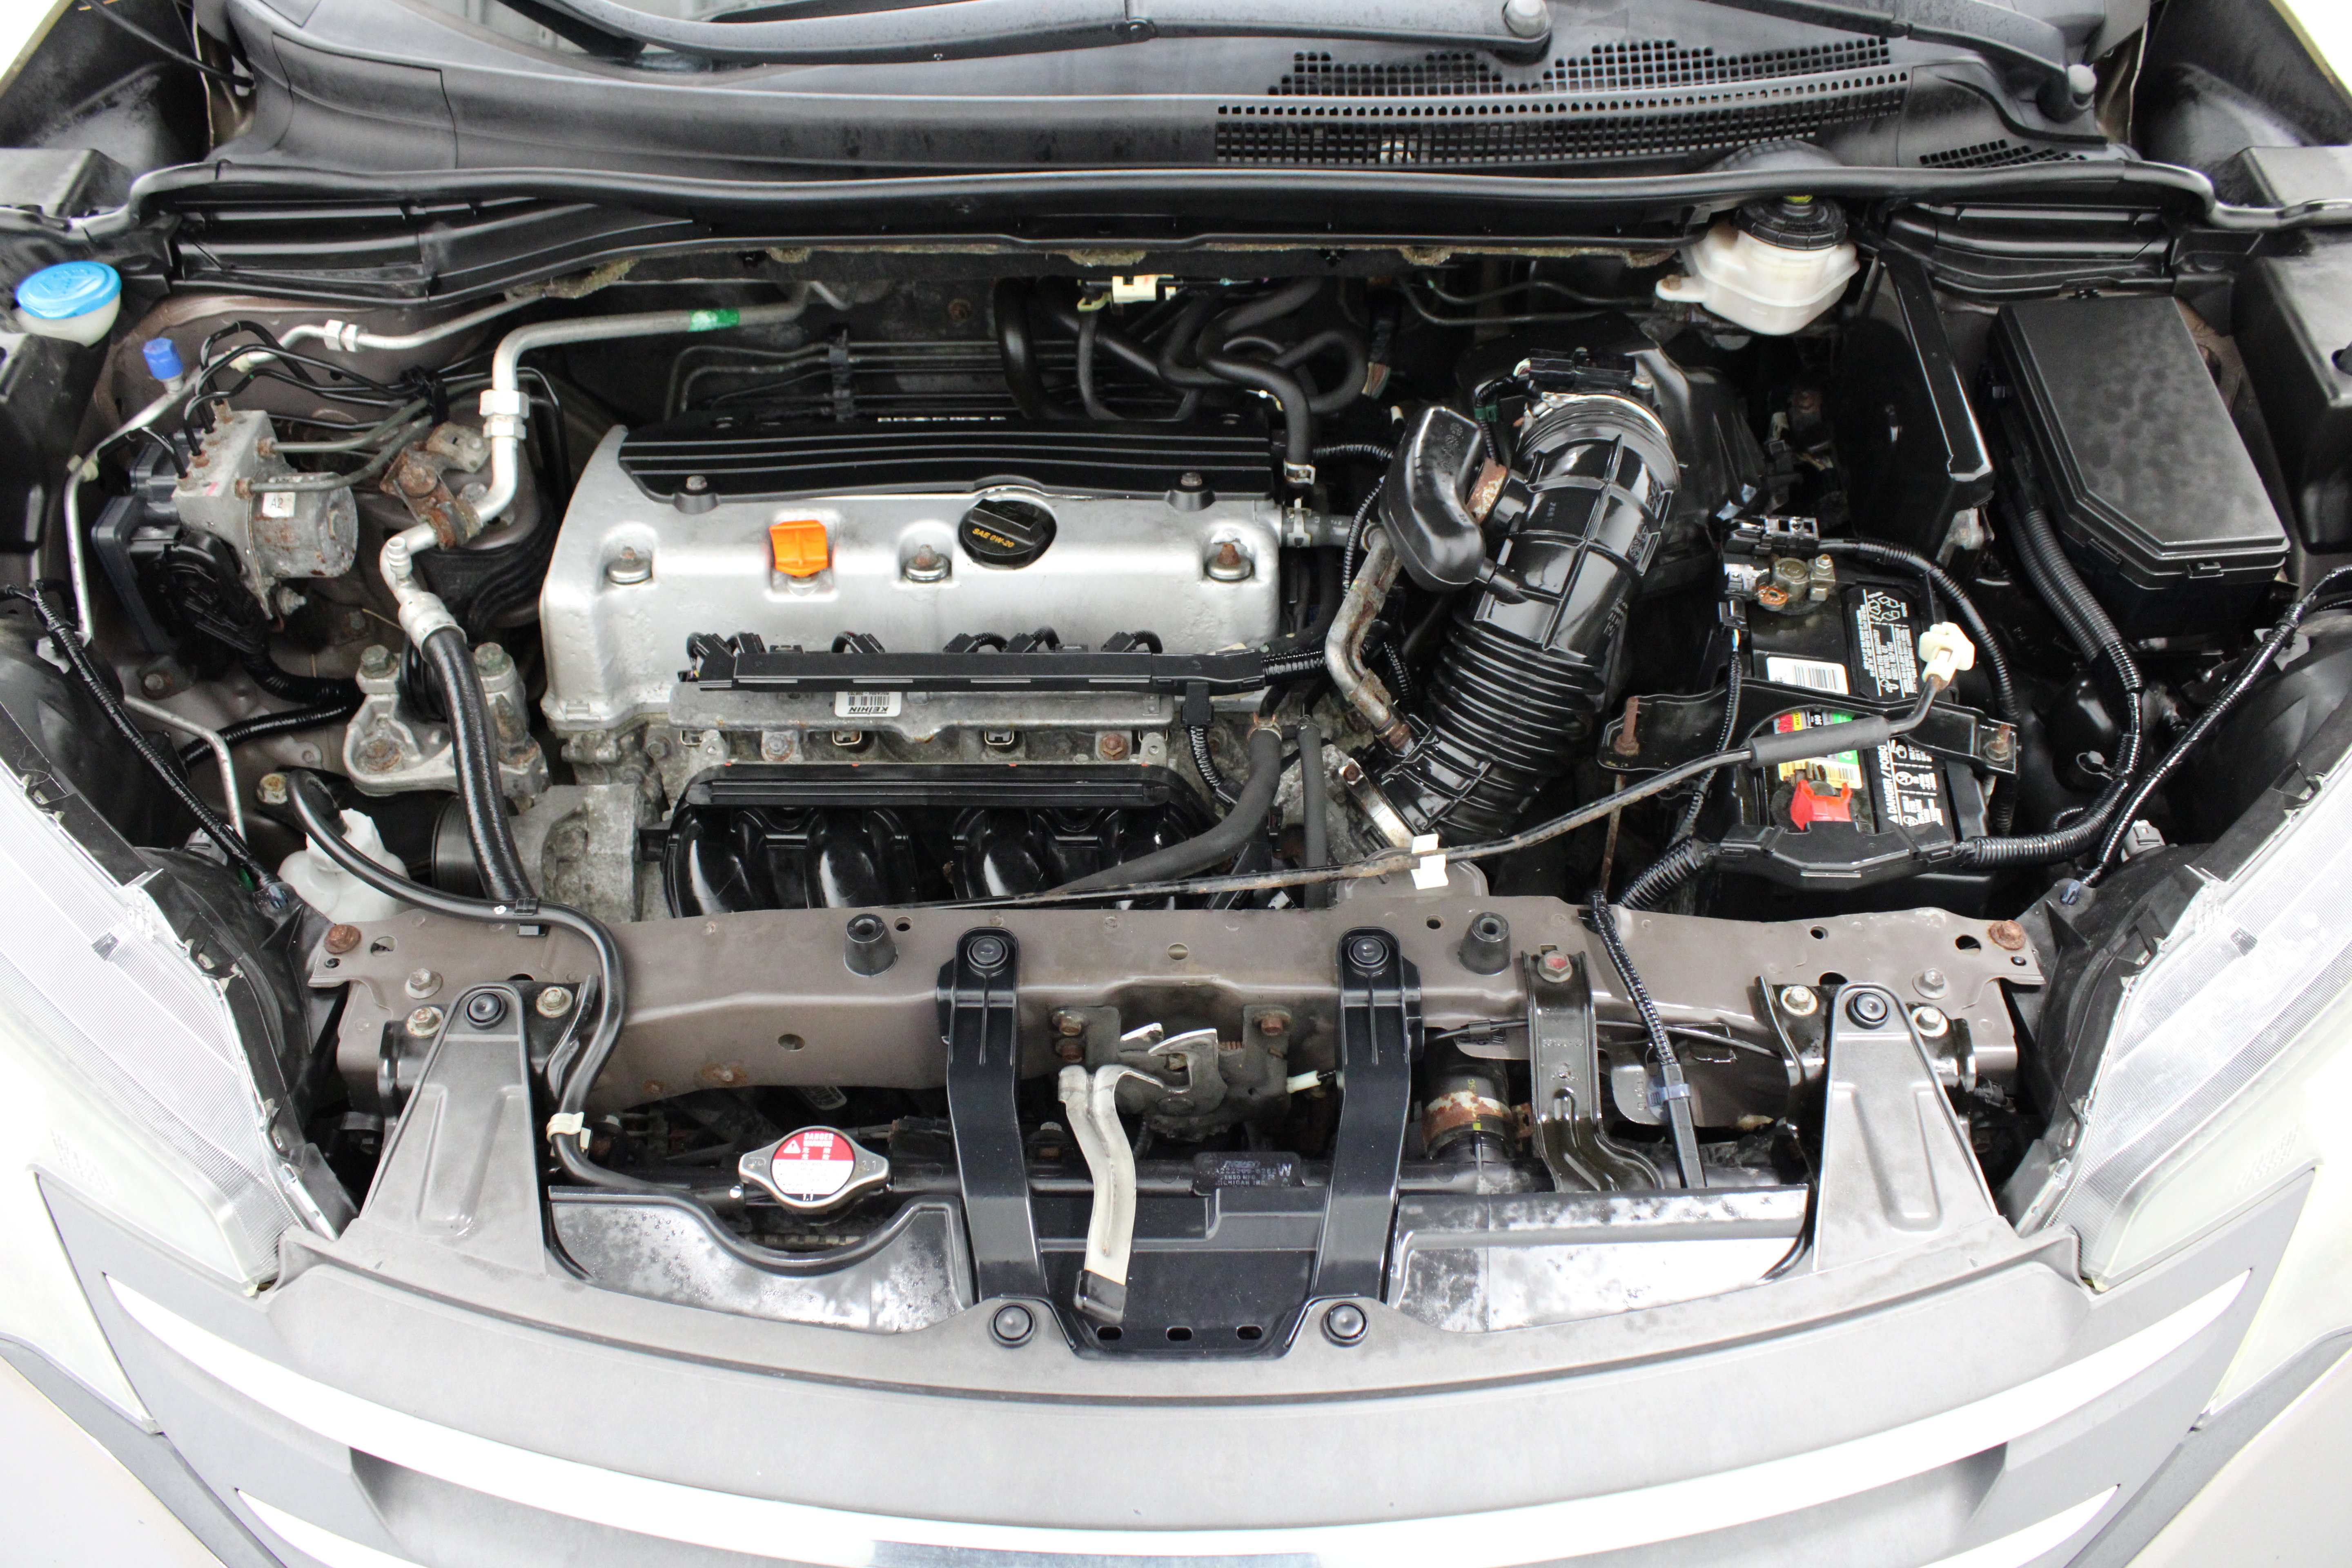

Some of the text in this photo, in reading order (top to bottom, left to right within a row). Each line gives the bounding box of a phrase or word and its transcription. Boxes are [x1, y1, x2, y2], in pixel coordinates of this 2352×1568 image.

[270, 497, 283, 508] A2
[972, 528, 1015, 548] SAE 0W-20
[1873, 629, 1882, 655] IMMEDIATELY
[849, 706, 889, 714] KEIHIN
[1814, 715, 1823, 726] 500
[1877, 745, 1891, 770] POISO
[1883, 778, 1898, 814] DANGER
[1276, 1163, 1292, 1176] W
